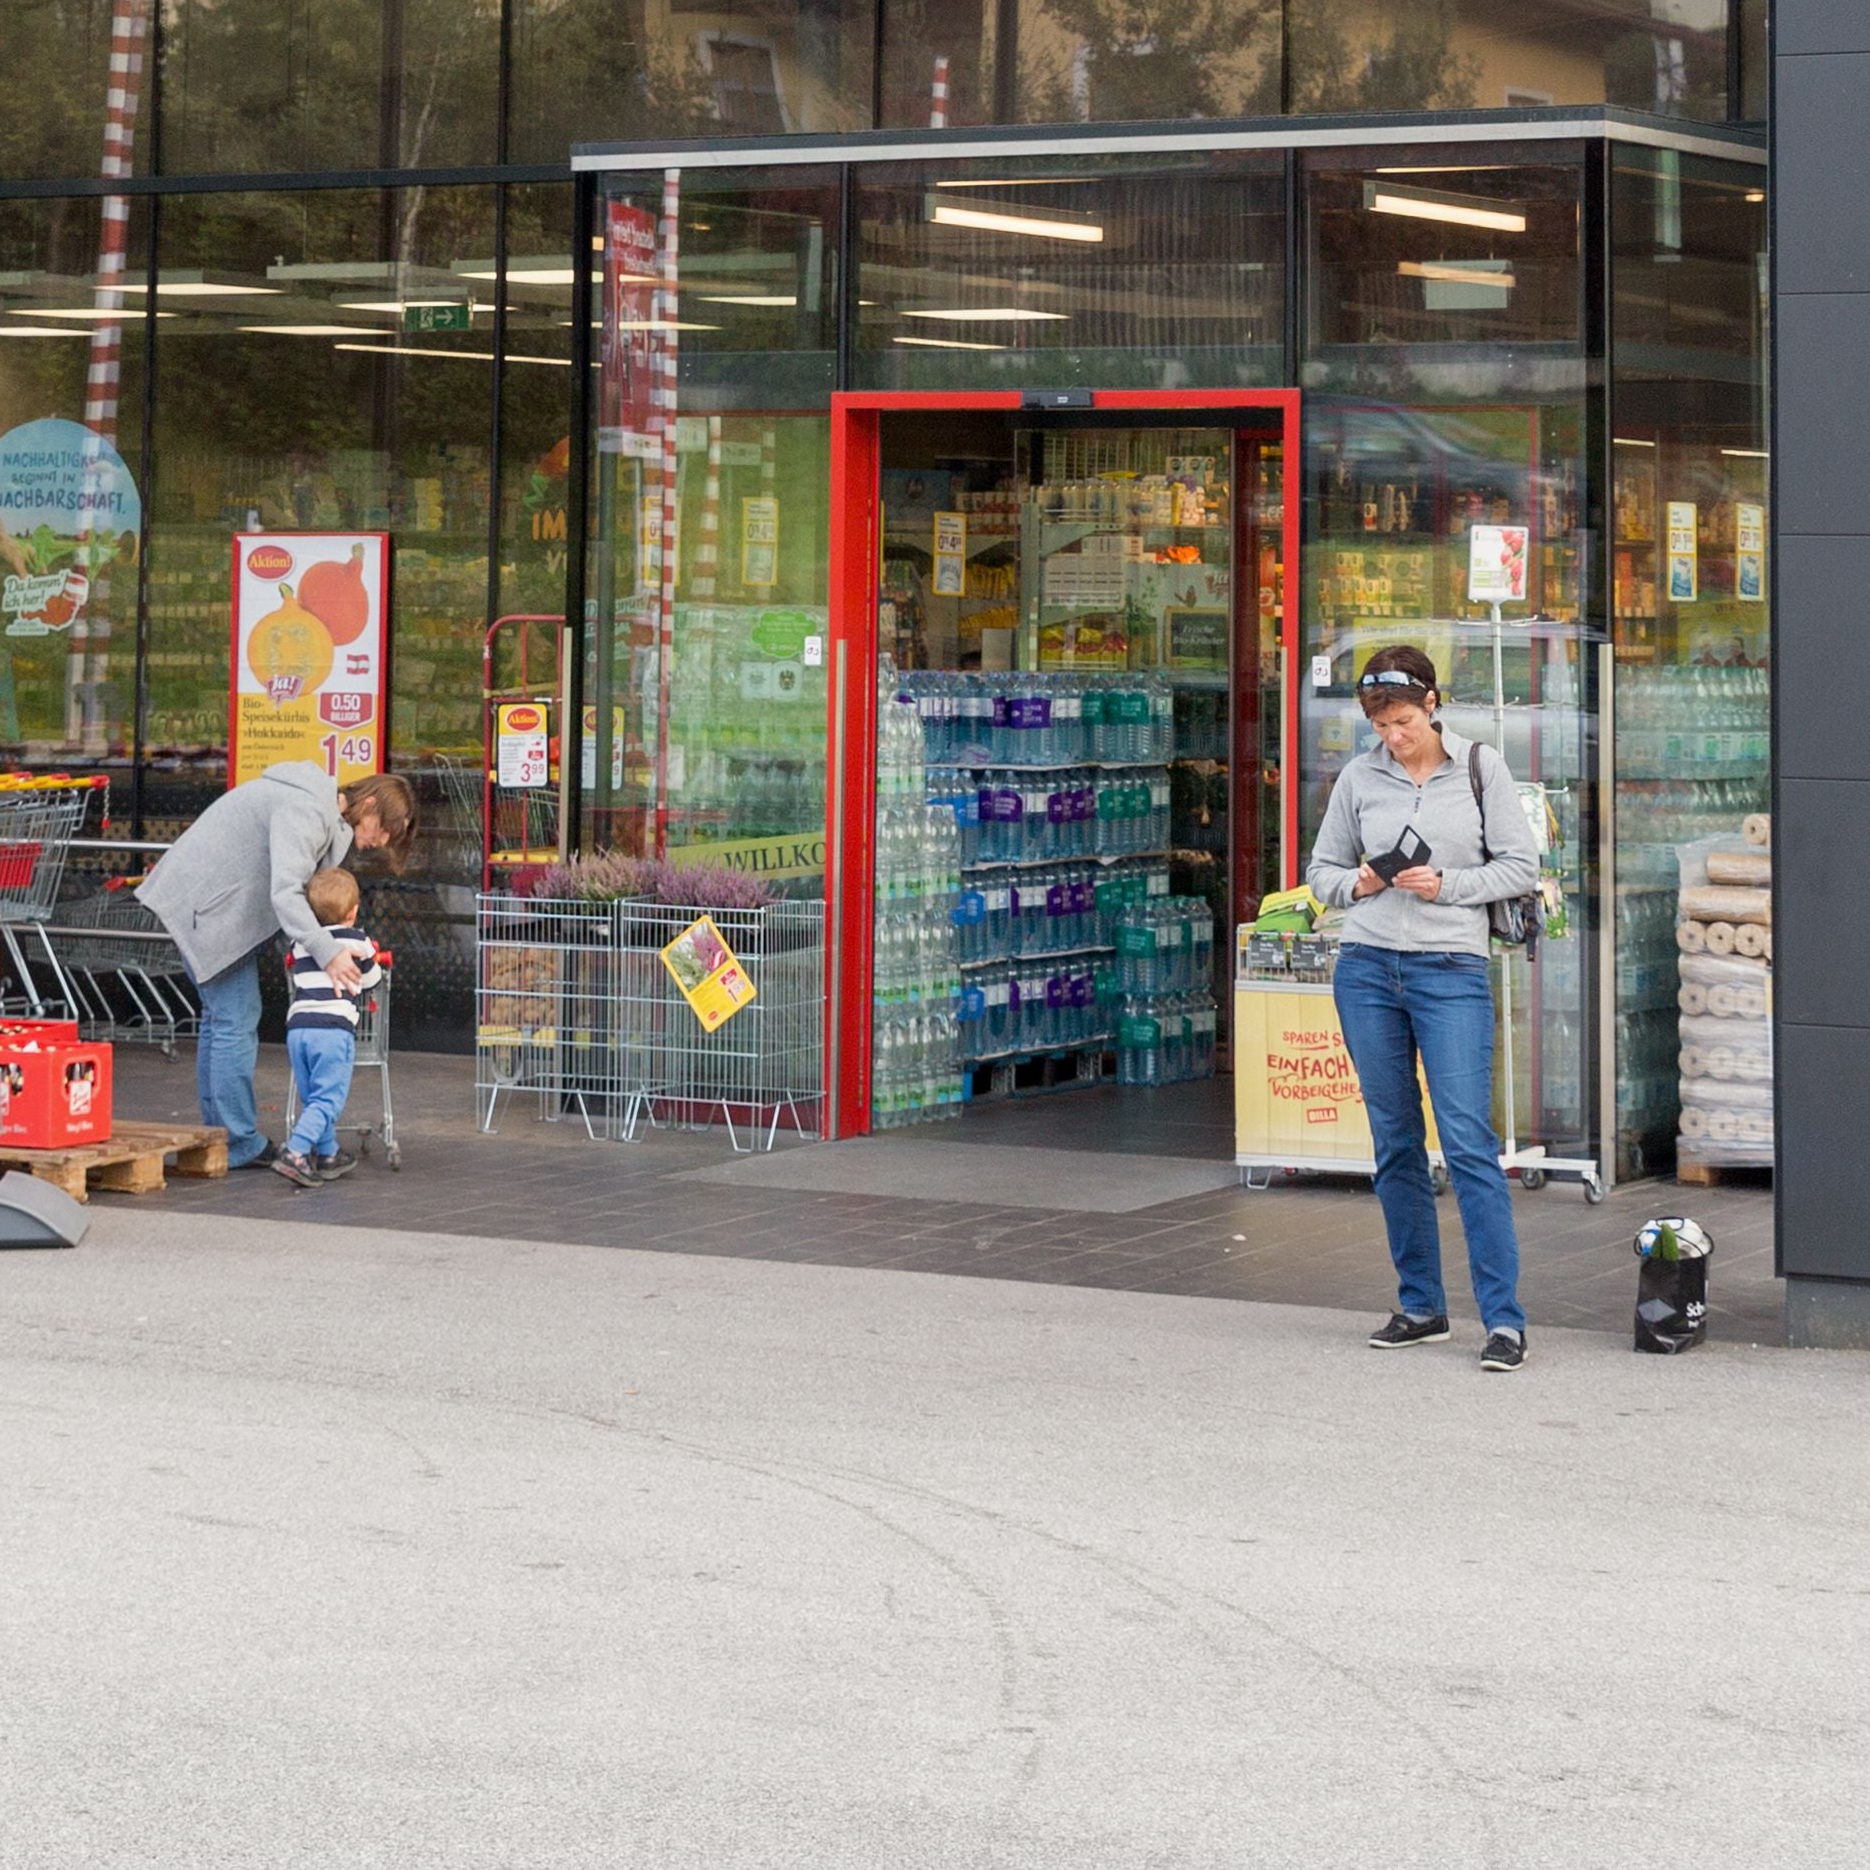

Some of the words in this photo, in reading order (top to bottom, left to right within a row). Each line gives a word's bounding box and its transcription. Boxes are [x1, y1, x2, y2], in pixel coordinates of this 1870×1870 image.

[3, 449, 108, 469] NACHHALTIGKE
[248, 554, 292, 570] Aktion!
[272, 674, 296, 692] ja!
[331, 694, 361, 711] 0.50
[242, 711, 310, 725] Speisekürbis
[1282, 1030, 1329, 1045] SPAREN
[1267, 1053, 1350, 1080] EINFACH
[1308, 1108, 1337, 1123] BILLA
